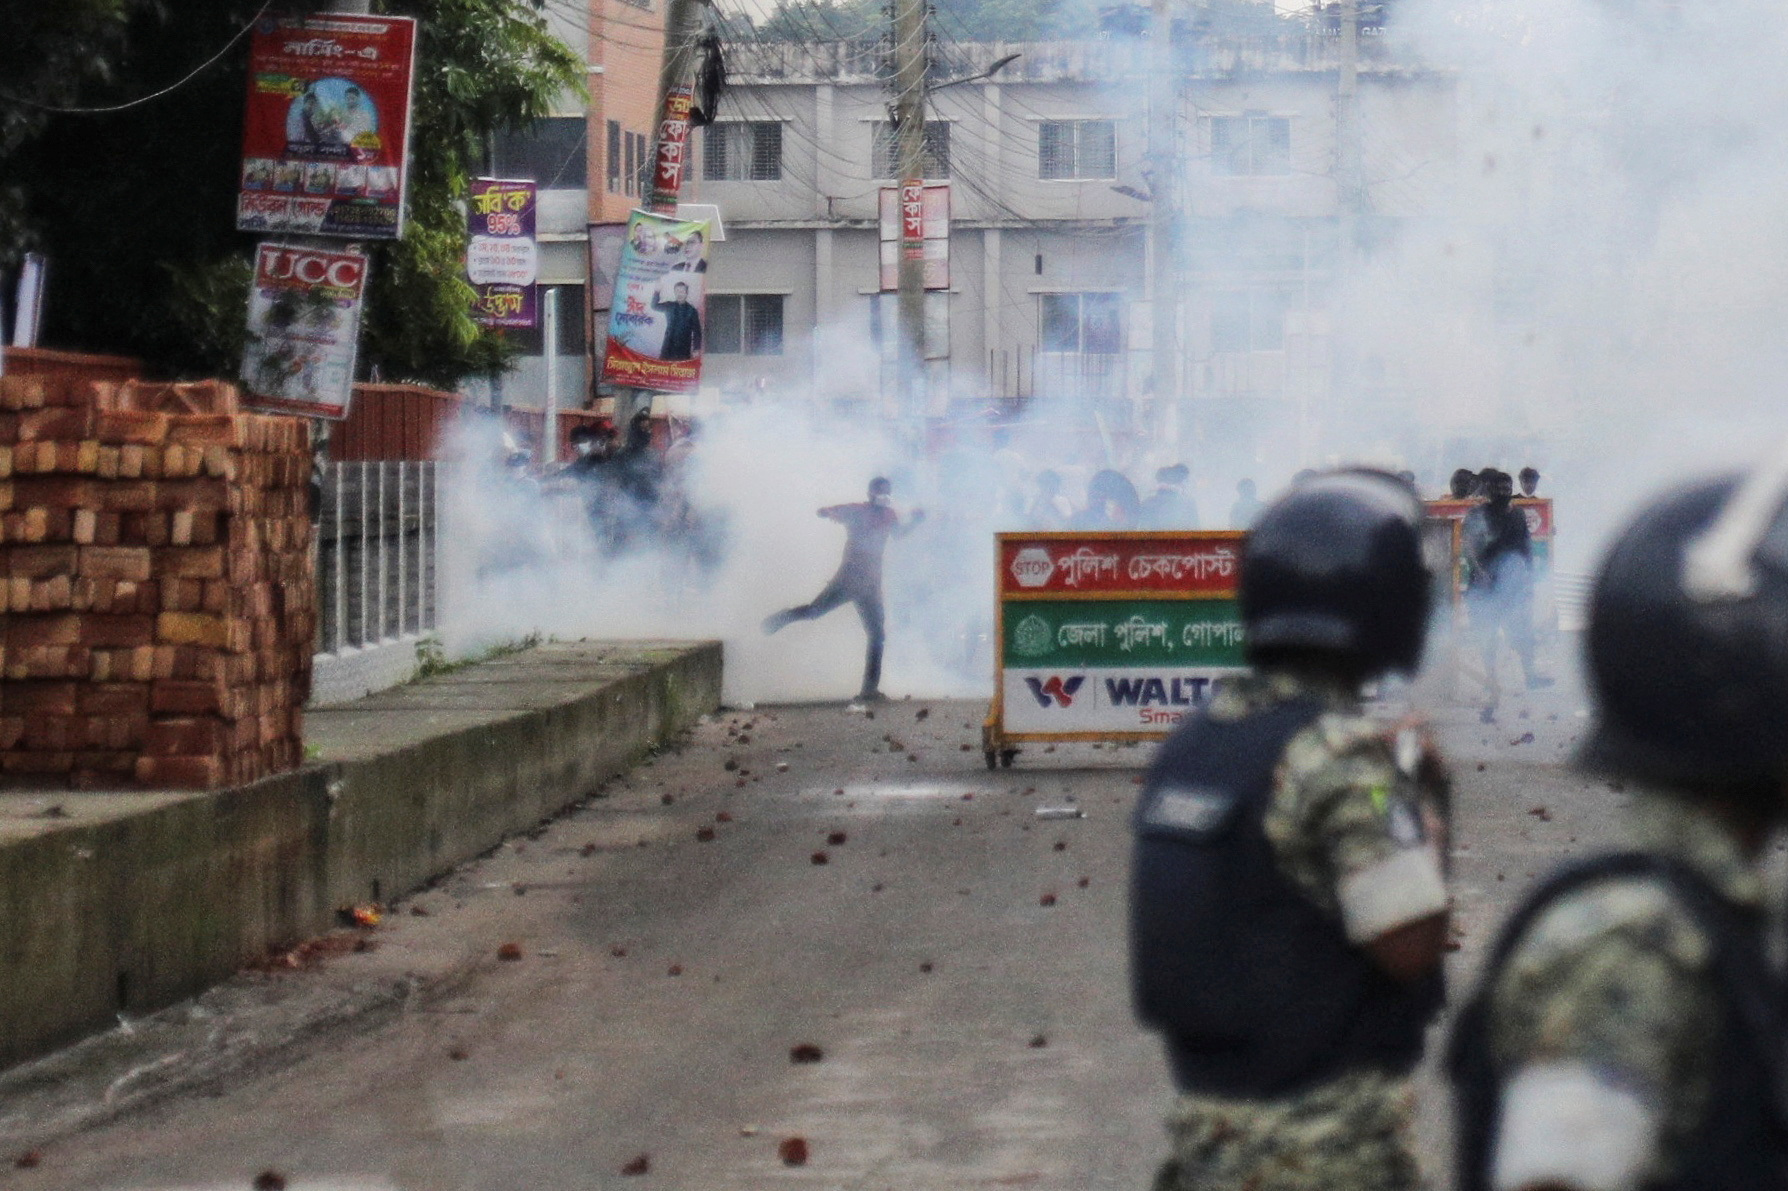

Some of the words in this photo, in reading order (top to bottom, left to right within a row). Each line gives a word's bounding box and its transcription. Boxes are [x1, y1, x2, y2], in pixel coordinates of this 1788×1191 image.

[487, 213, 521, 235] 95%
[263, 250, 361, 288] UCC
[1015, 560, 1050, 576] STOP
[1057, 546, 1120, 587] পুলিশ
[1128, 546, 1237, 581] চেকপোস্ট
[1057, 622, 1107, 647] জেলা
